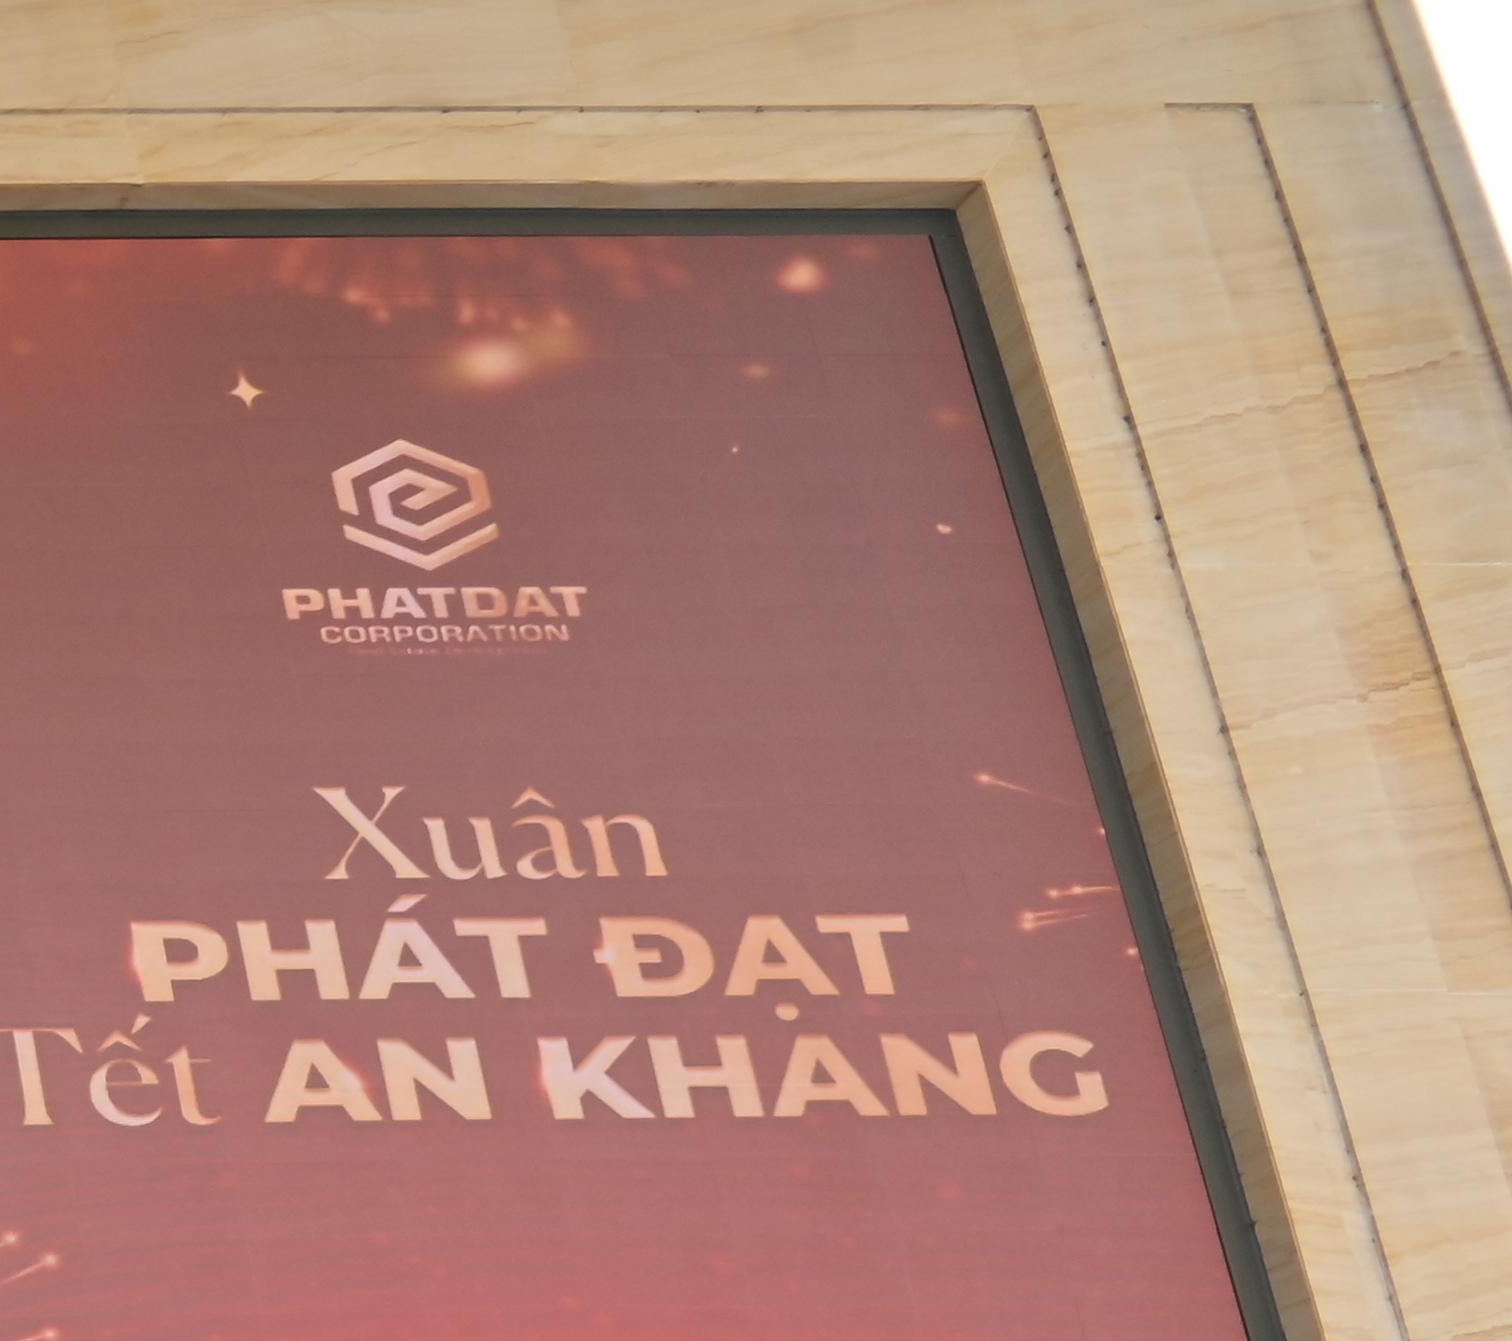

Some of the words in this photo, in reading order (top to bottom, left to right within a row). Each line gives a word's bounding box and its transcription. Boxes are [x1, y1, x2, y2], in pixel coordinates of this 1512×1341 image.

[281, 586, 588, 620] PHATDAT
[319, 624, 571, 644] CORPORATION
[311, 785, 668, 880] Xuân
[128, 893, 548, 1003] PHÁT
[594, 912, 911, 1022] ĐẠT
[264, 1036, 493, 1122] AN
[537, 1031, 1111, 1121] KHANG
